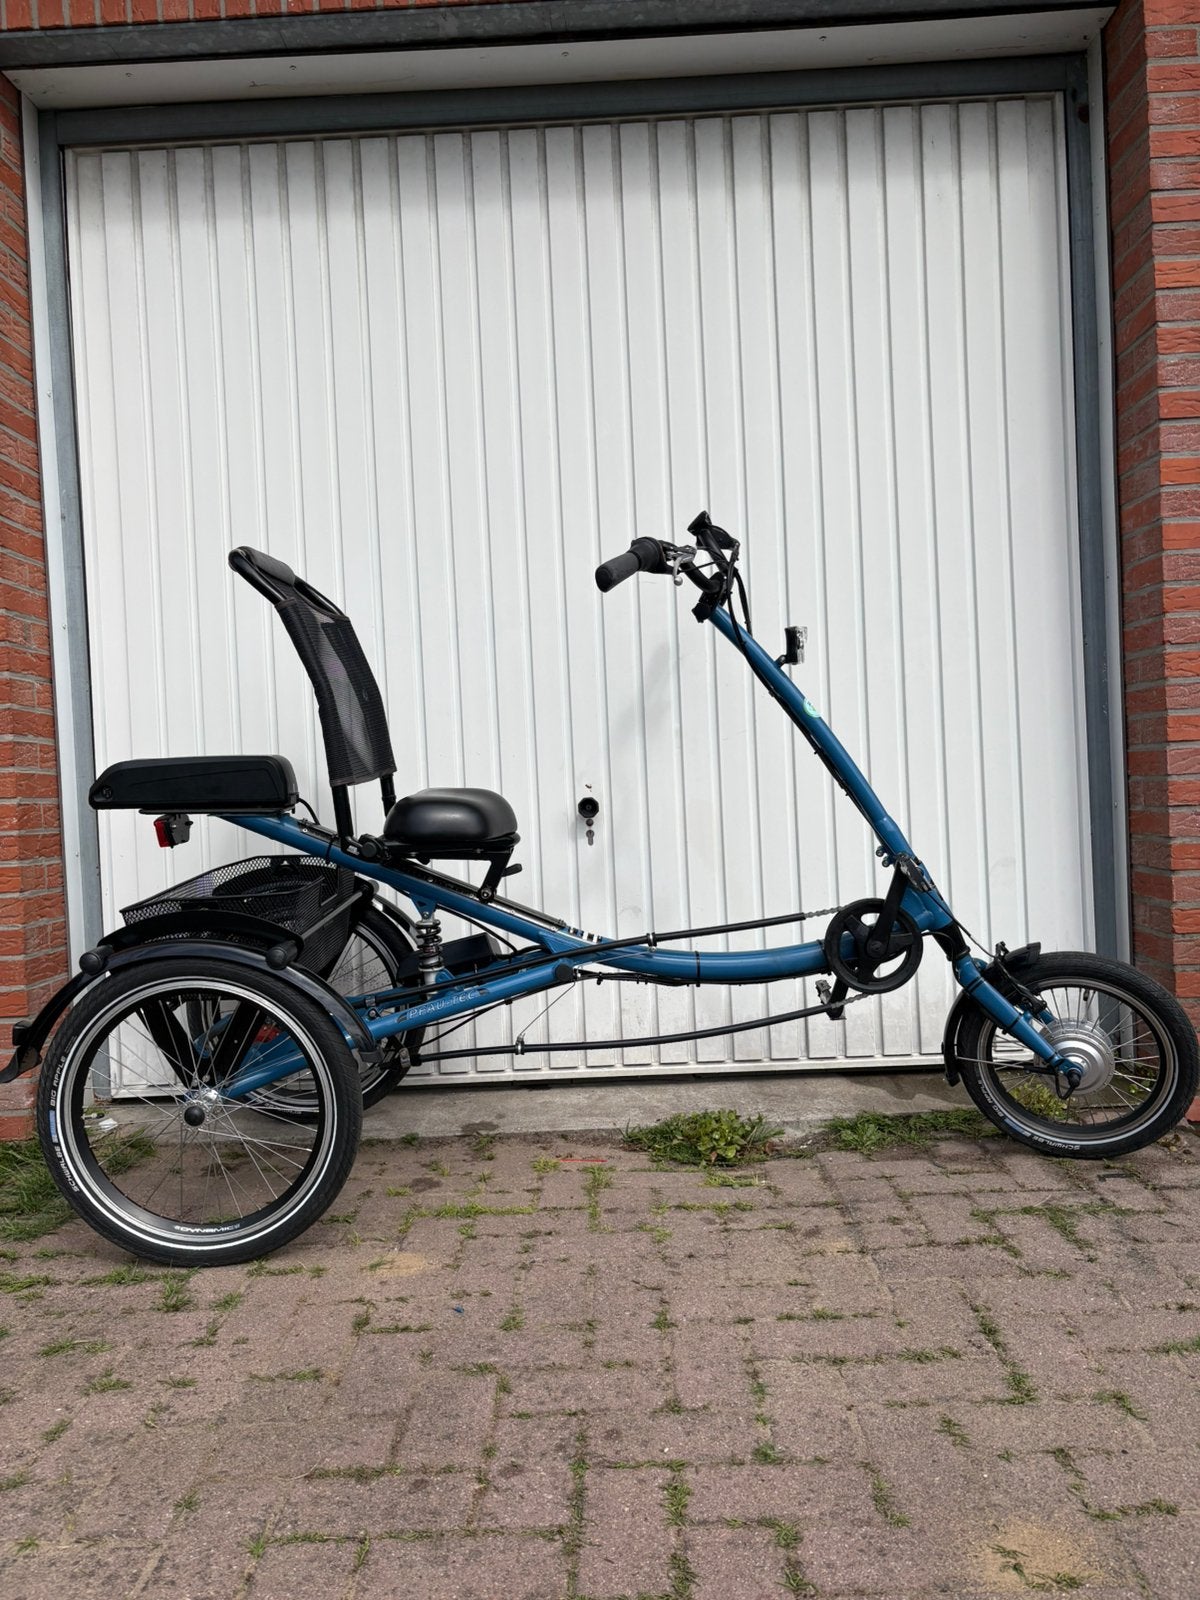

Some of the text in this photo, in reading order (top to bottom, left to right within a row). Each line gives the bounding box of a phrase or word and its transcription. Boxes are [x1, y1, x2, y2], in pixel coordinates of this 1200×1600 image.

[53, 1055, 66, 1087] APPLE
[1032, 1135, 1080, 1150] SCHWALBE
[54, 1146, 80, 1193] SCHWALBE
